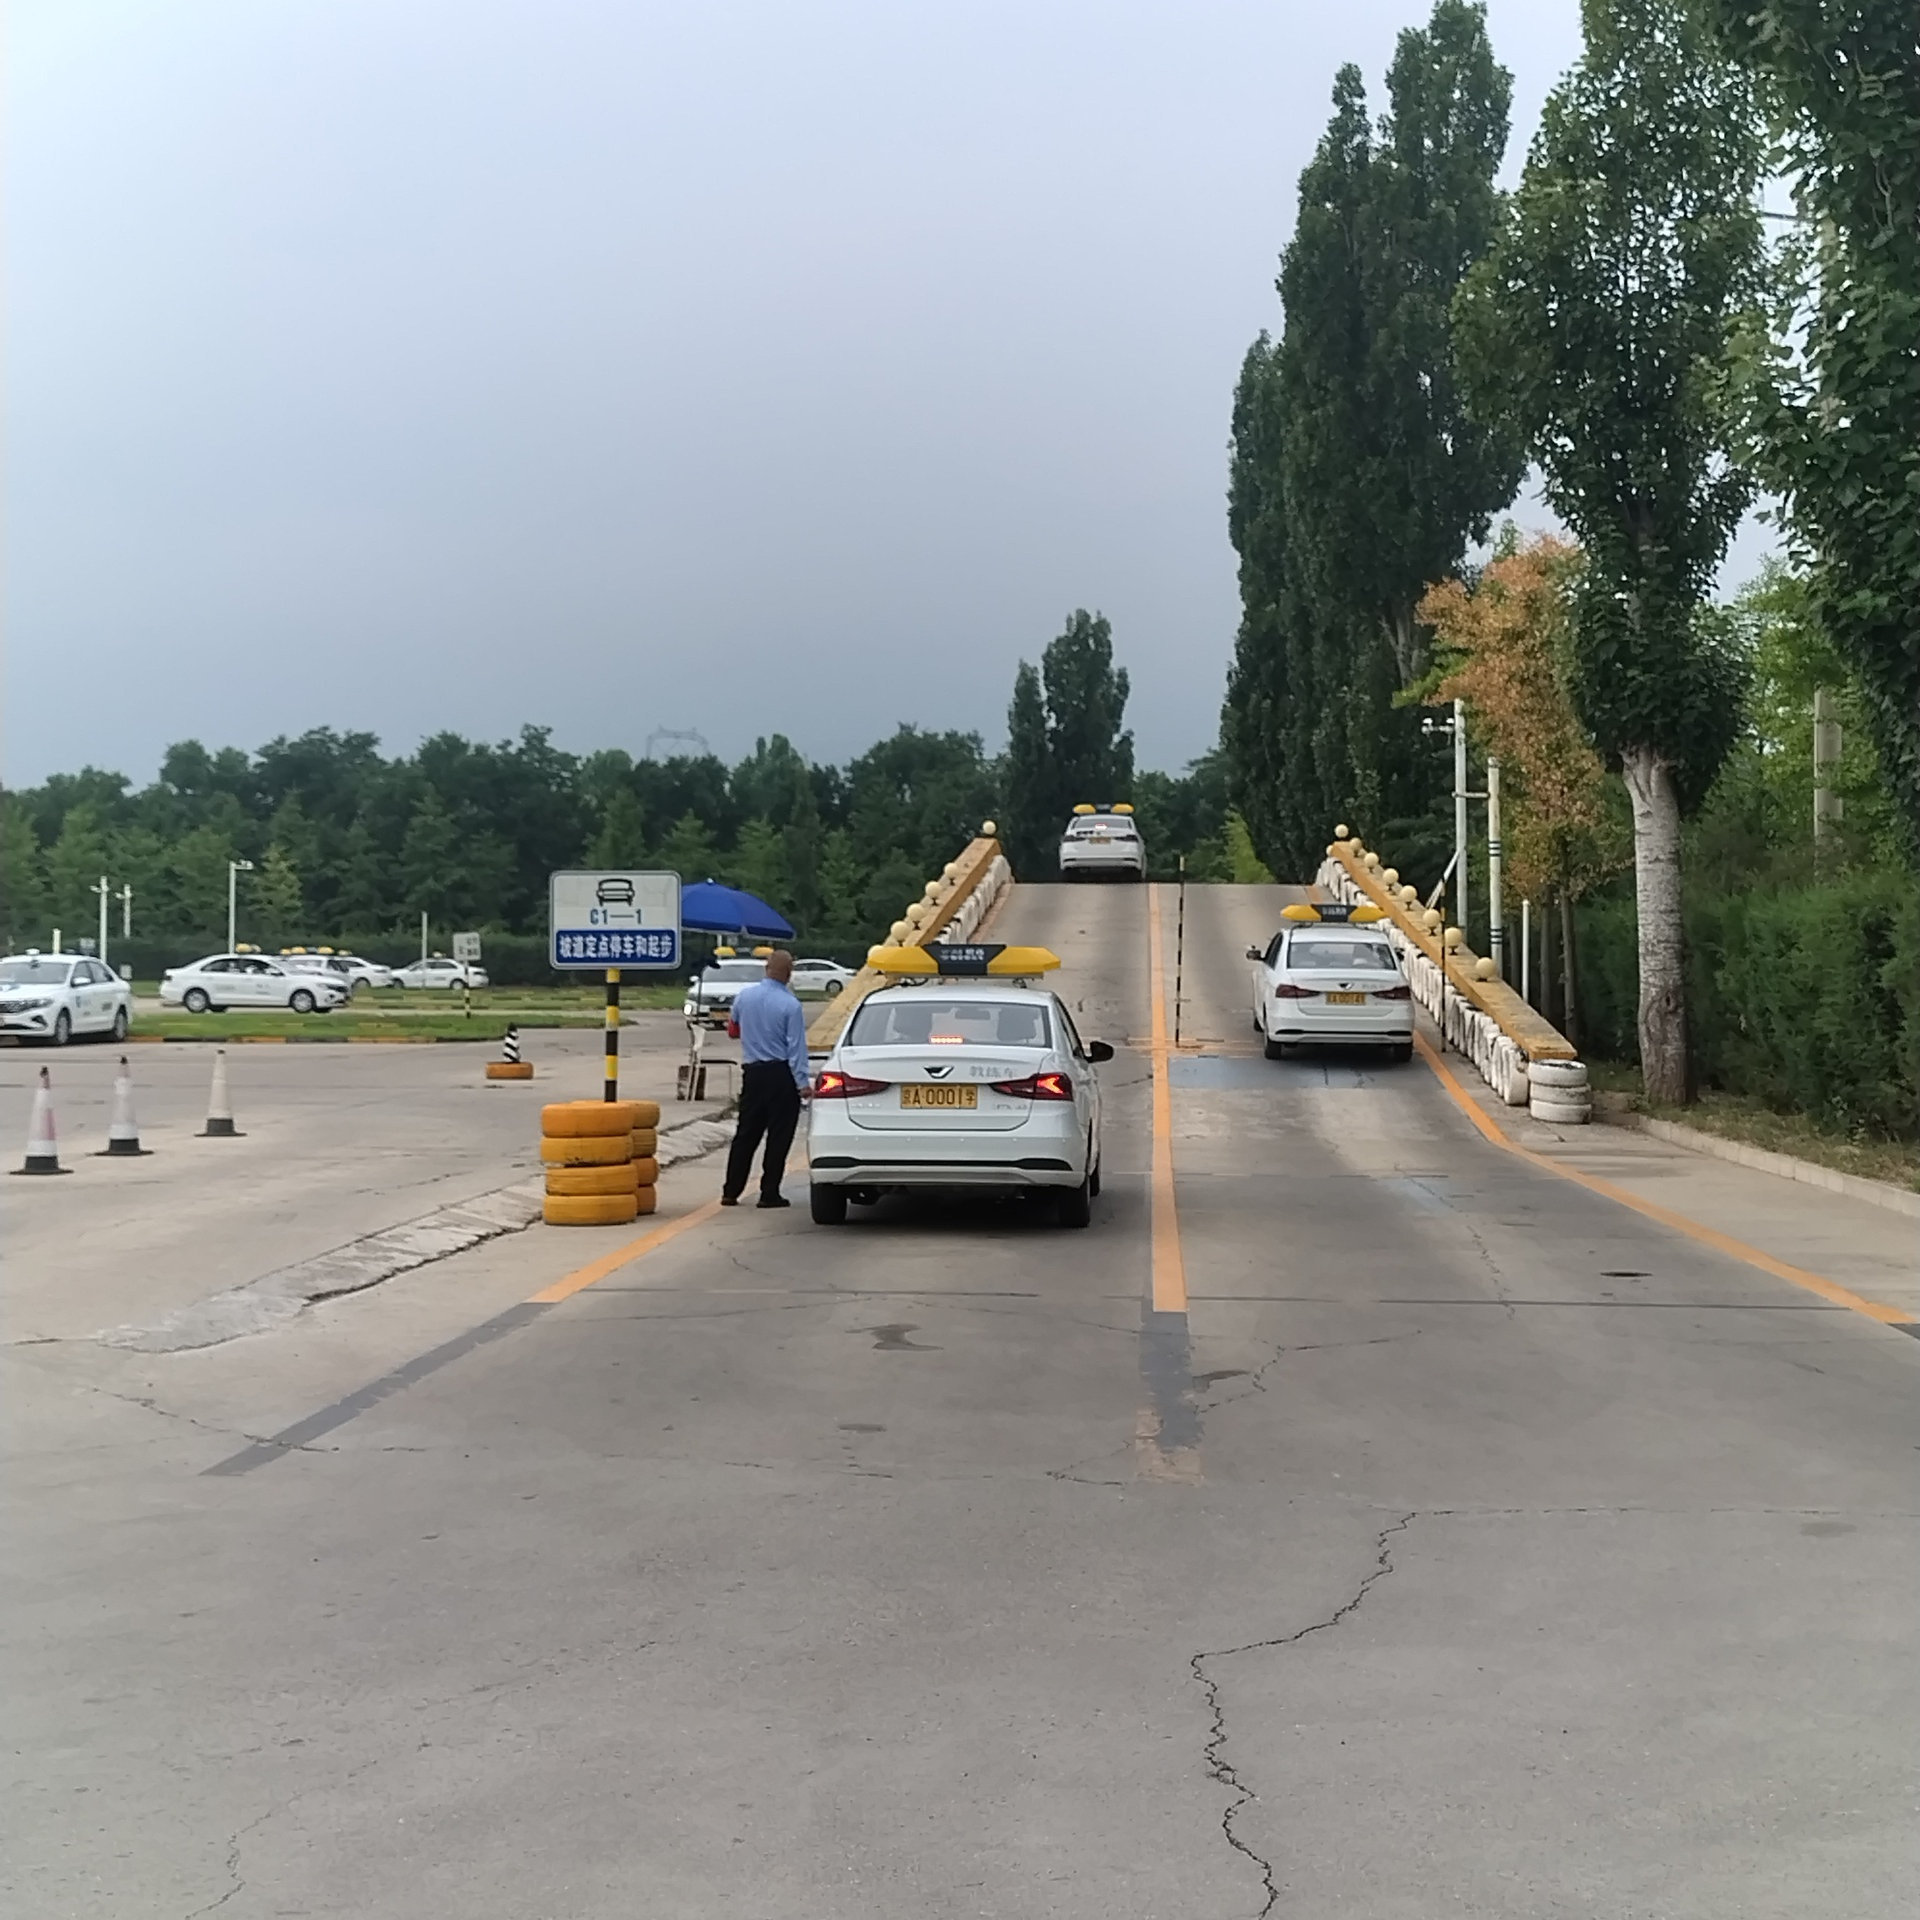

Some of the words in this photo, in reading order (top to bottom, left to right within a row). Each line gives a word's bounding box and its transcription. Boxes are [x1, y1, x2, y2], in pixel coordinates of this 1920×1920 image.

[559, 934, 673, 958] 坡道定点停车和起步
